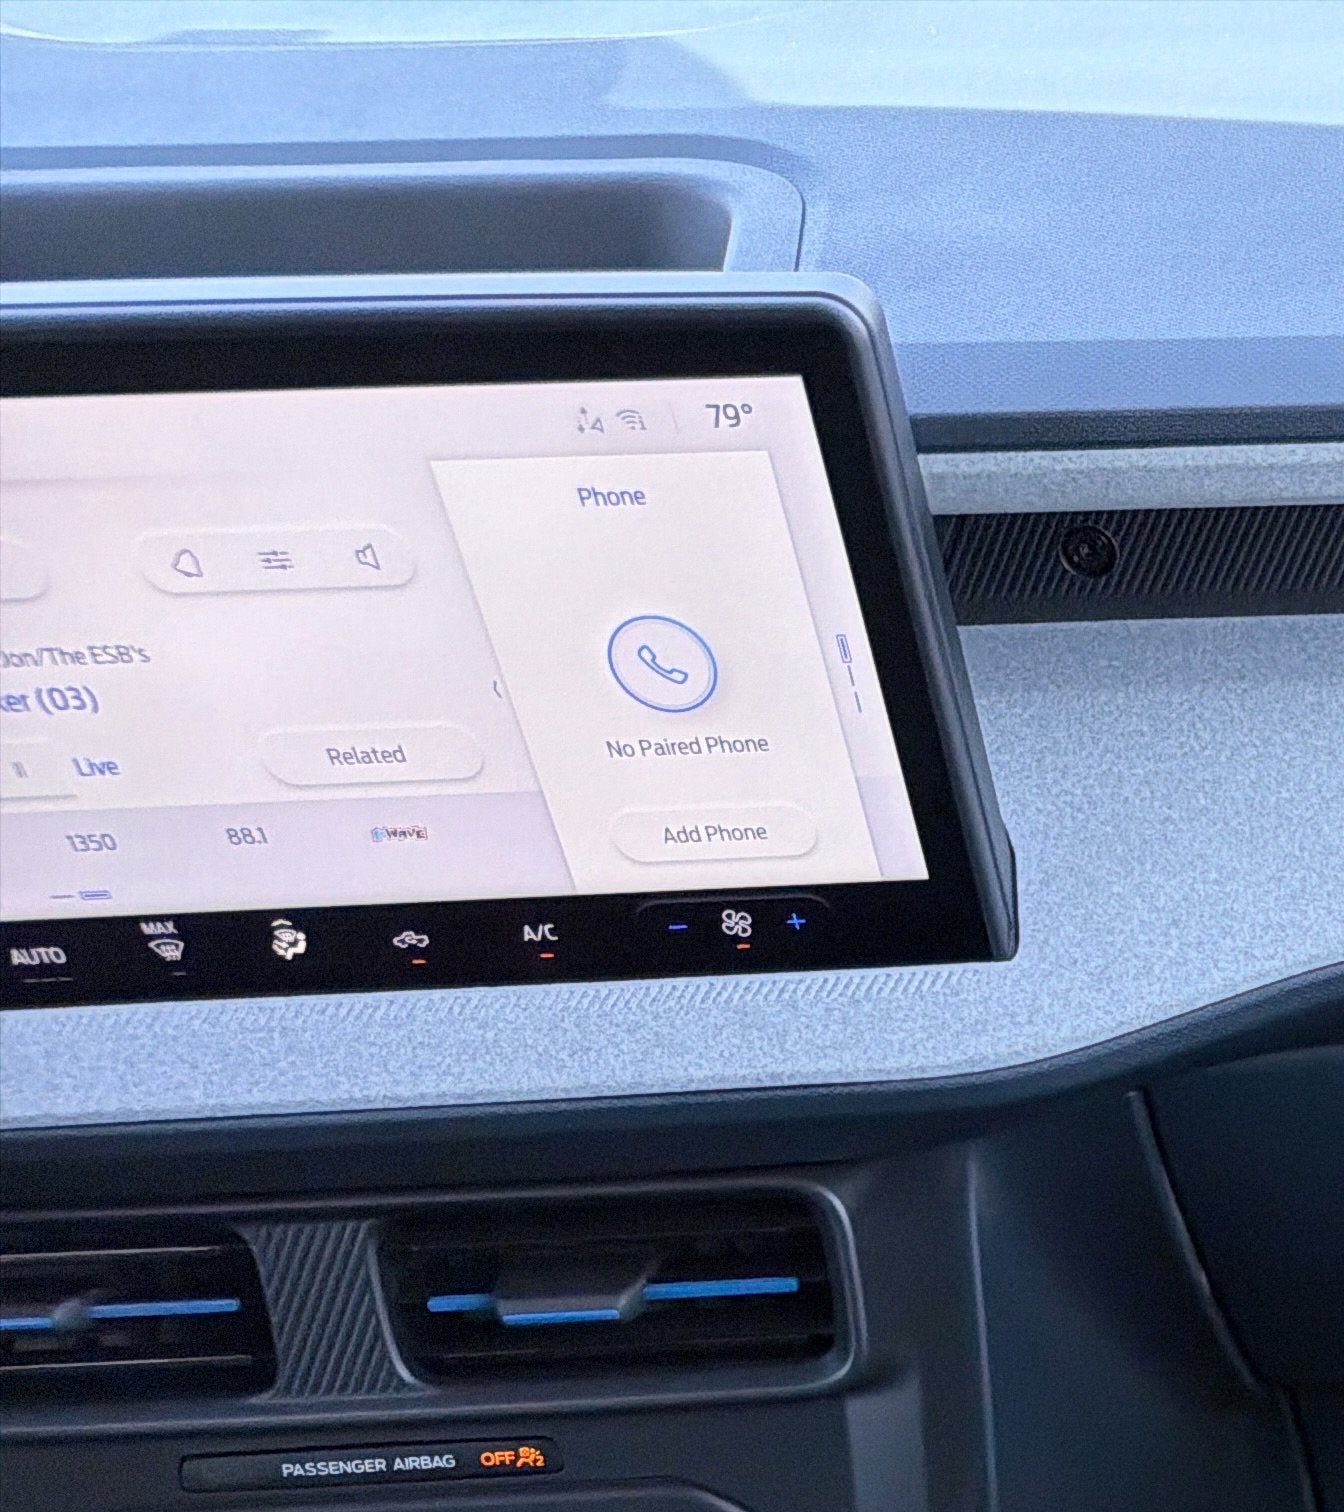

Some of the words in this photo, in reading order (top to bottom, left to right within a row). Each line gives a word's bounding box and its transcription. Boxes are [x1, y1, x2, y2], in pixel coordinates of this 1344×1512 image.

[577, 487, 646, 507] Phone
[35, 685, 99, 715] (03)
[326, 745, 407, 766] Related
[606, 740, 635, 759] No
[640, 736, 702, 756] Paired
[705, 735, 769, 754] Phone
[72, 757, 121, 777] Live
[66, 833, 117, 851] 1350
[226, 827, 268, 845] 88.1
[663, 826, 702, 845] Add
[705, 823, 768, 843] Phone
[139, 921, 178, 935] MAX
[523, 923, 559, 942] A/C
[10, 947, 67, 966] AUTO
[281, 1458, 387, 1478] PASSENGER
[393, 1454, 456, 1471] AIRBAG
[480, 1451, 515, 1468] OFF
